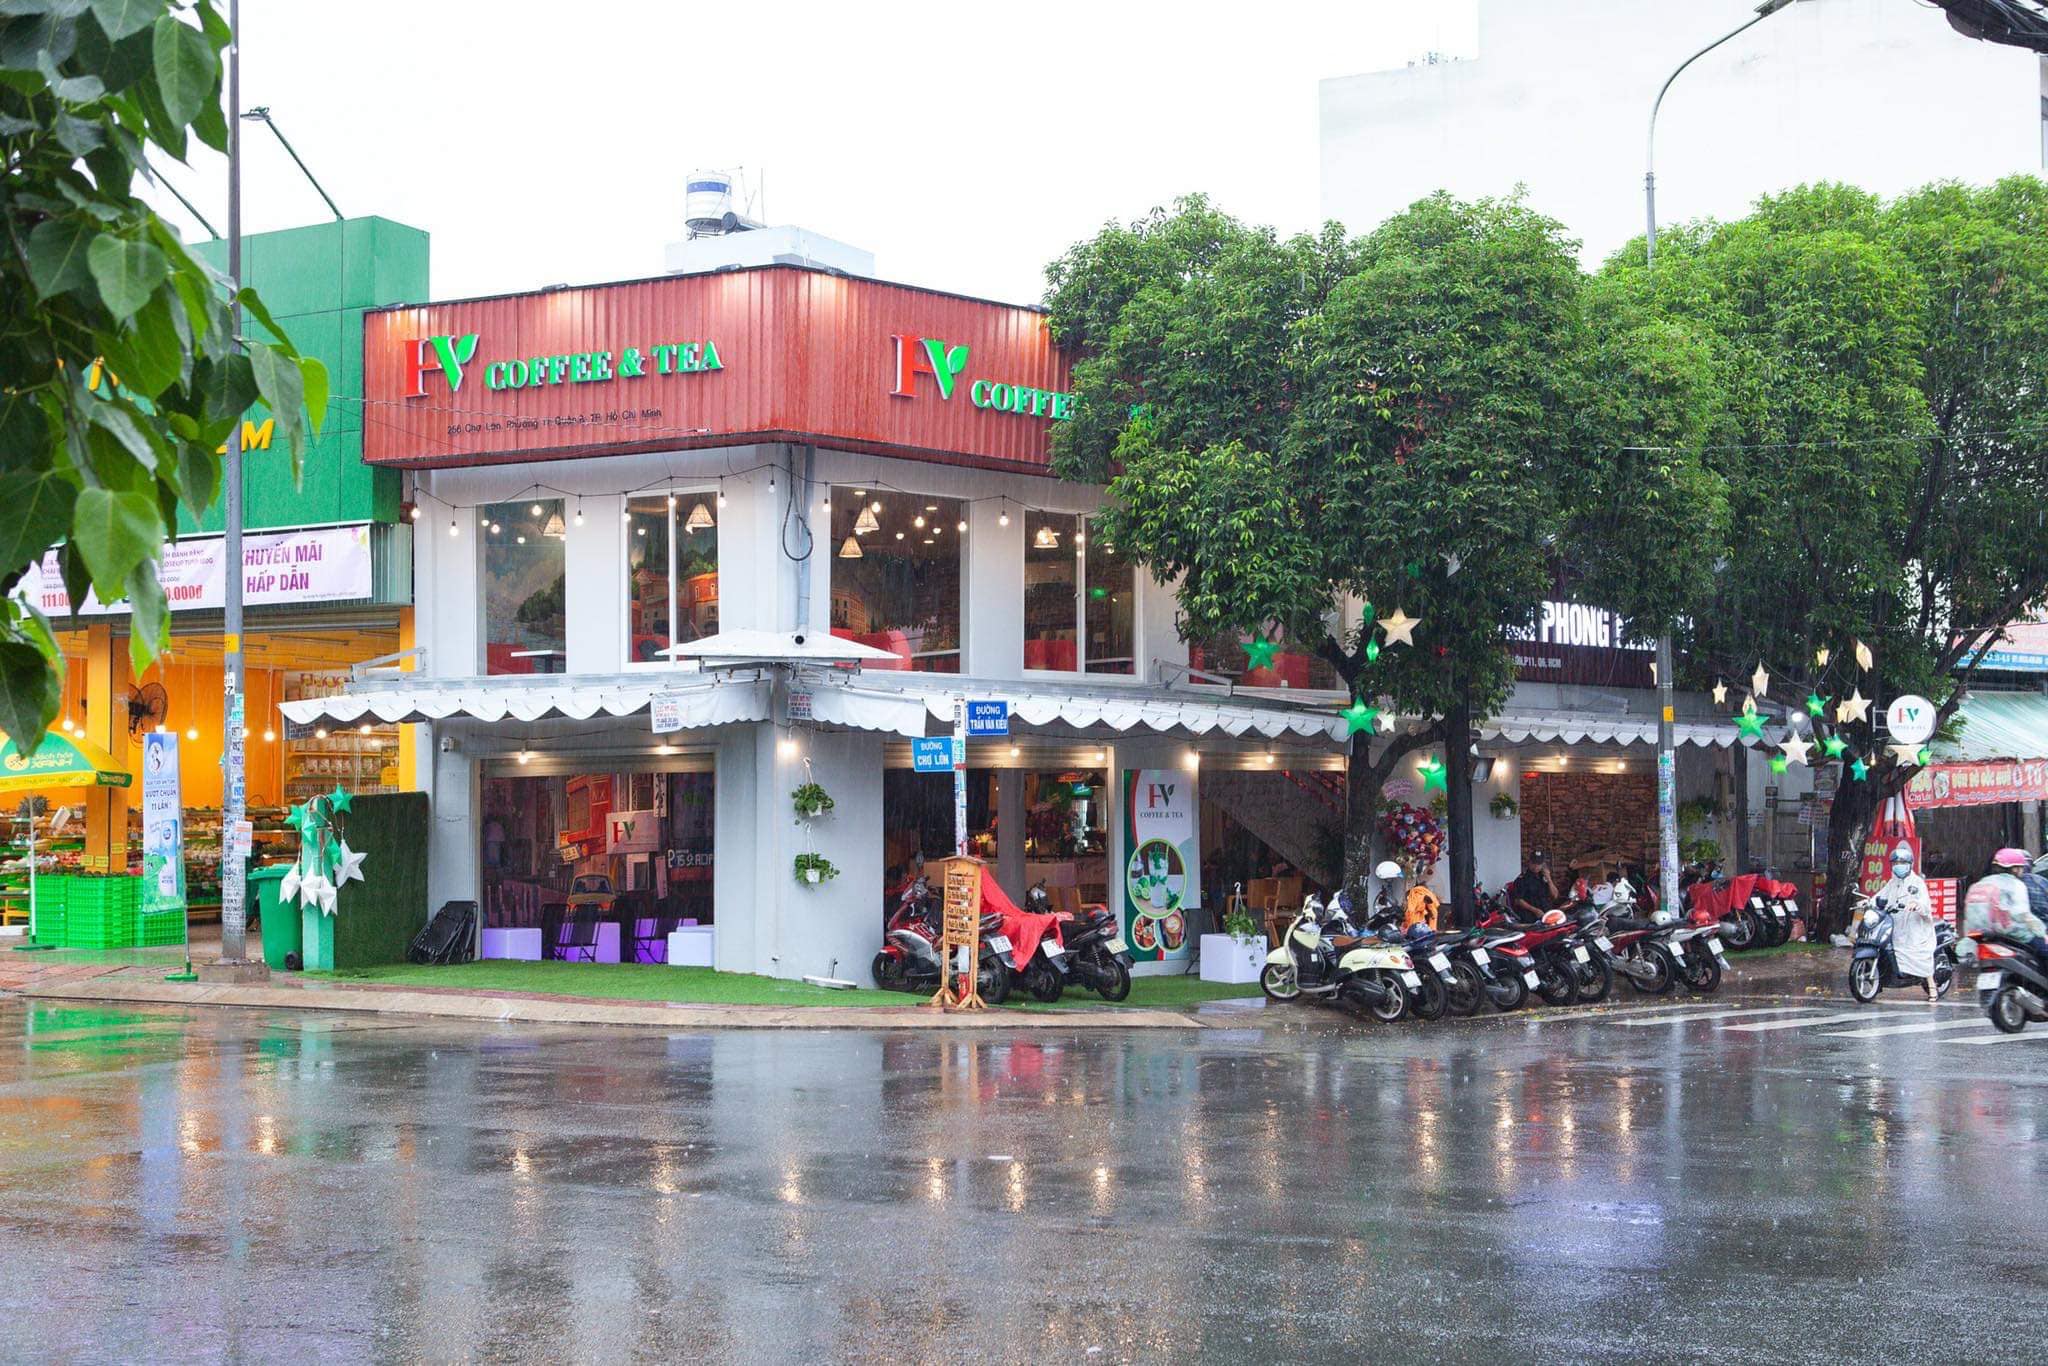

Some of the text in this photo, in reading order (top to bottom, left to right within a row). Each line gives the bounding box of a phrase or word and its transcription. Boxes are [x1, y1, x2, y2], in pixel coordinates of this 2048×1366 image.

[485, 351, 612, 391] COFFEE
[618, 347, 645, 378] &
[652, 340, 724, 376] TEA
[970, 379, 1077, 421] COFFE
[242, 540, 322, 566] HUYẾN MÃI
[246, 565, 309, 593] HẤP DẪN
[1542, 600, 1609, 647] PHONG
[976, 704, 1000, 714] ĐƯỜNG
[917, 754, 931, 768] CHỢ
[1864, 840, 1888, 856] BÚN
[1868, 858, 1883, 874] BÒ
